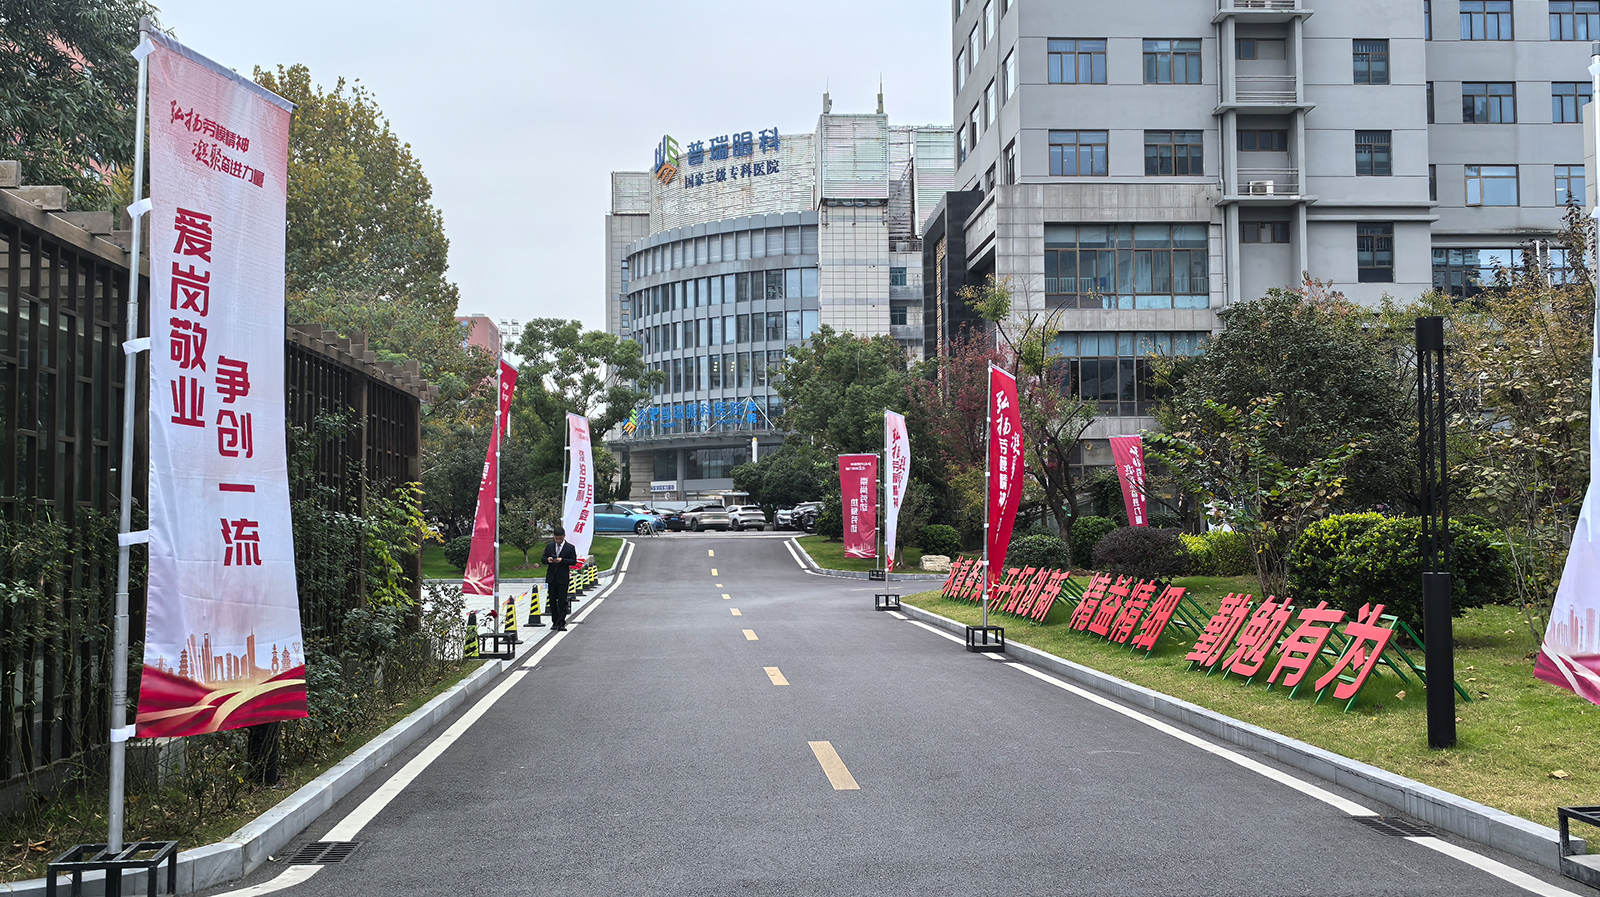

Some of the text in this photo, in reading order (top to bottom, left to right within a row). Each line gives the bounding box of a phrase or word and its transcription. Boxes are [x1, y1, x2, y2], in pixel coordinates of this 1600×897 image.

[170, 100, 250, 153] 弘扬劳模精神
[687, 126, 781, 166] 普瑞眼科
[191, 139, 265, 188] 凝聚奋进力量
[684, 159, 780, 189] 国家三级专科医院
[169, 207, 213, 429] 爱岗敬业
[215, 355, 263, 567] 争创一流
[988, 564, 1071, 622] 开拓创新
[1068, 572, 1186, 652] 精益精细
[1184, 591, 1394, 700] 勤勉有为
